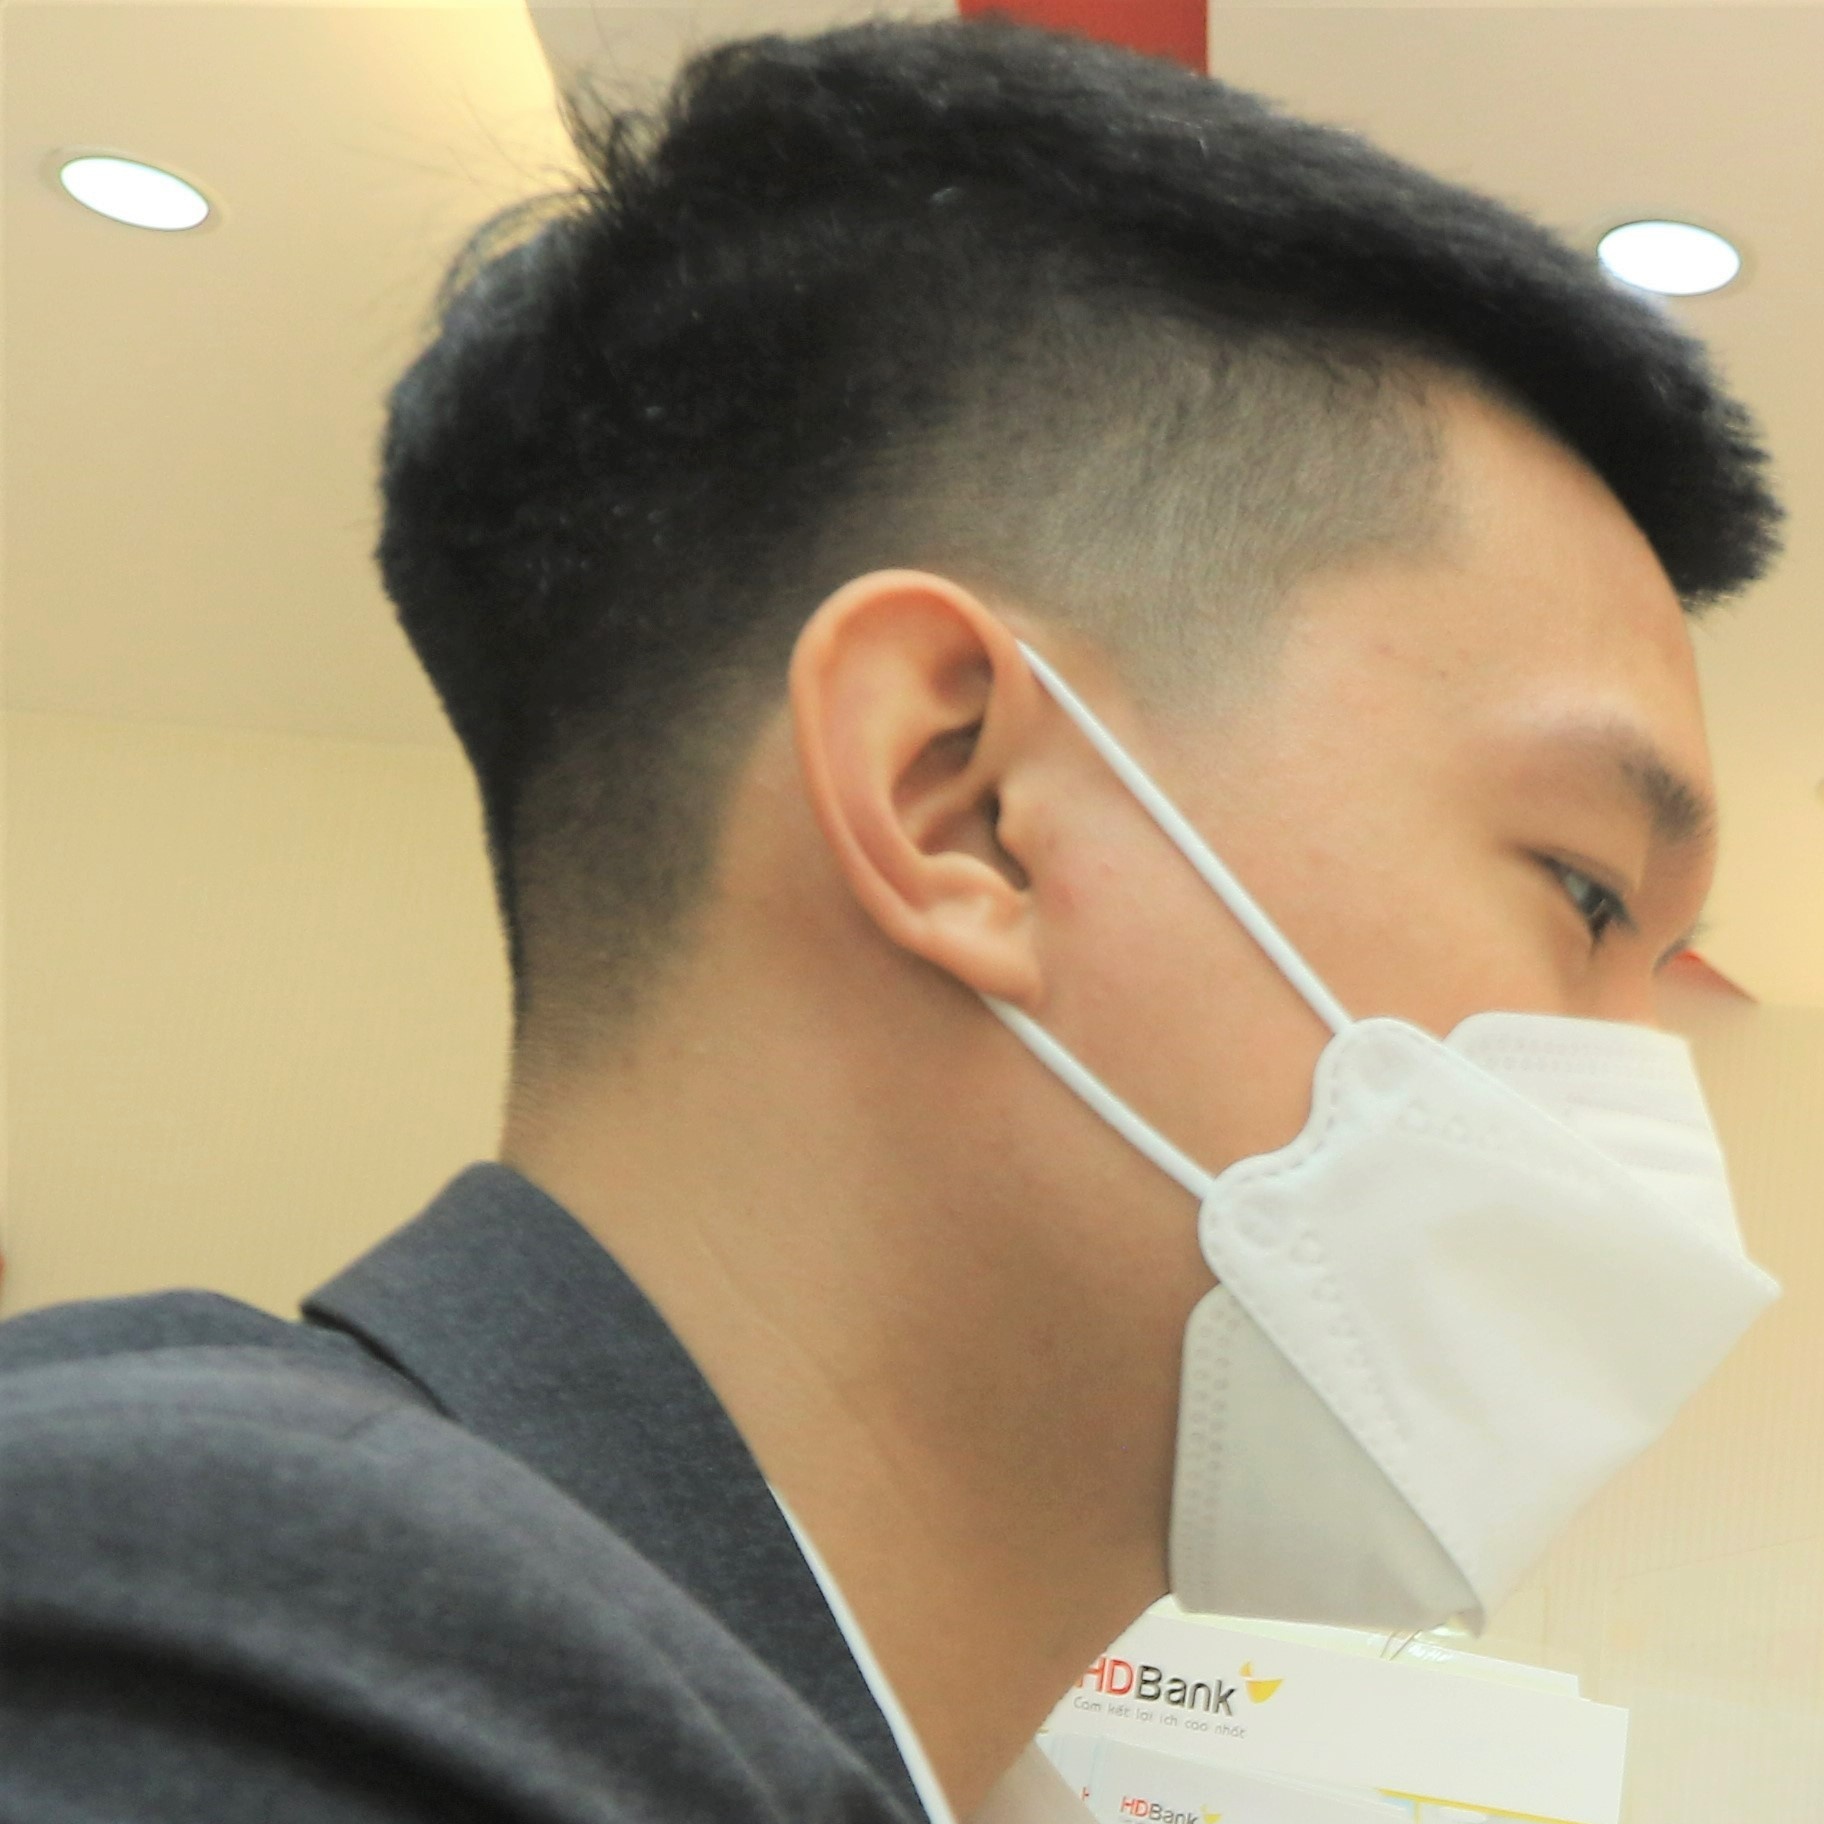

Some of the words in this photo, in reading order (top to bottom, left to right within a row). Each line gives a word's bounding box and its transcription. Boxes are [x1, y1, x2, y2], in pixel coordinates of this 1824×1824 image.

[1078, 1655, 1237, 1716] HDBank
[1073, 1696, 1100, 1711] Cam
[1108, 1703, 1130, 1718] kết
[1185, 1719, 1208, 1732] cao
[1215, 1724, 1248, 1739] nhất
